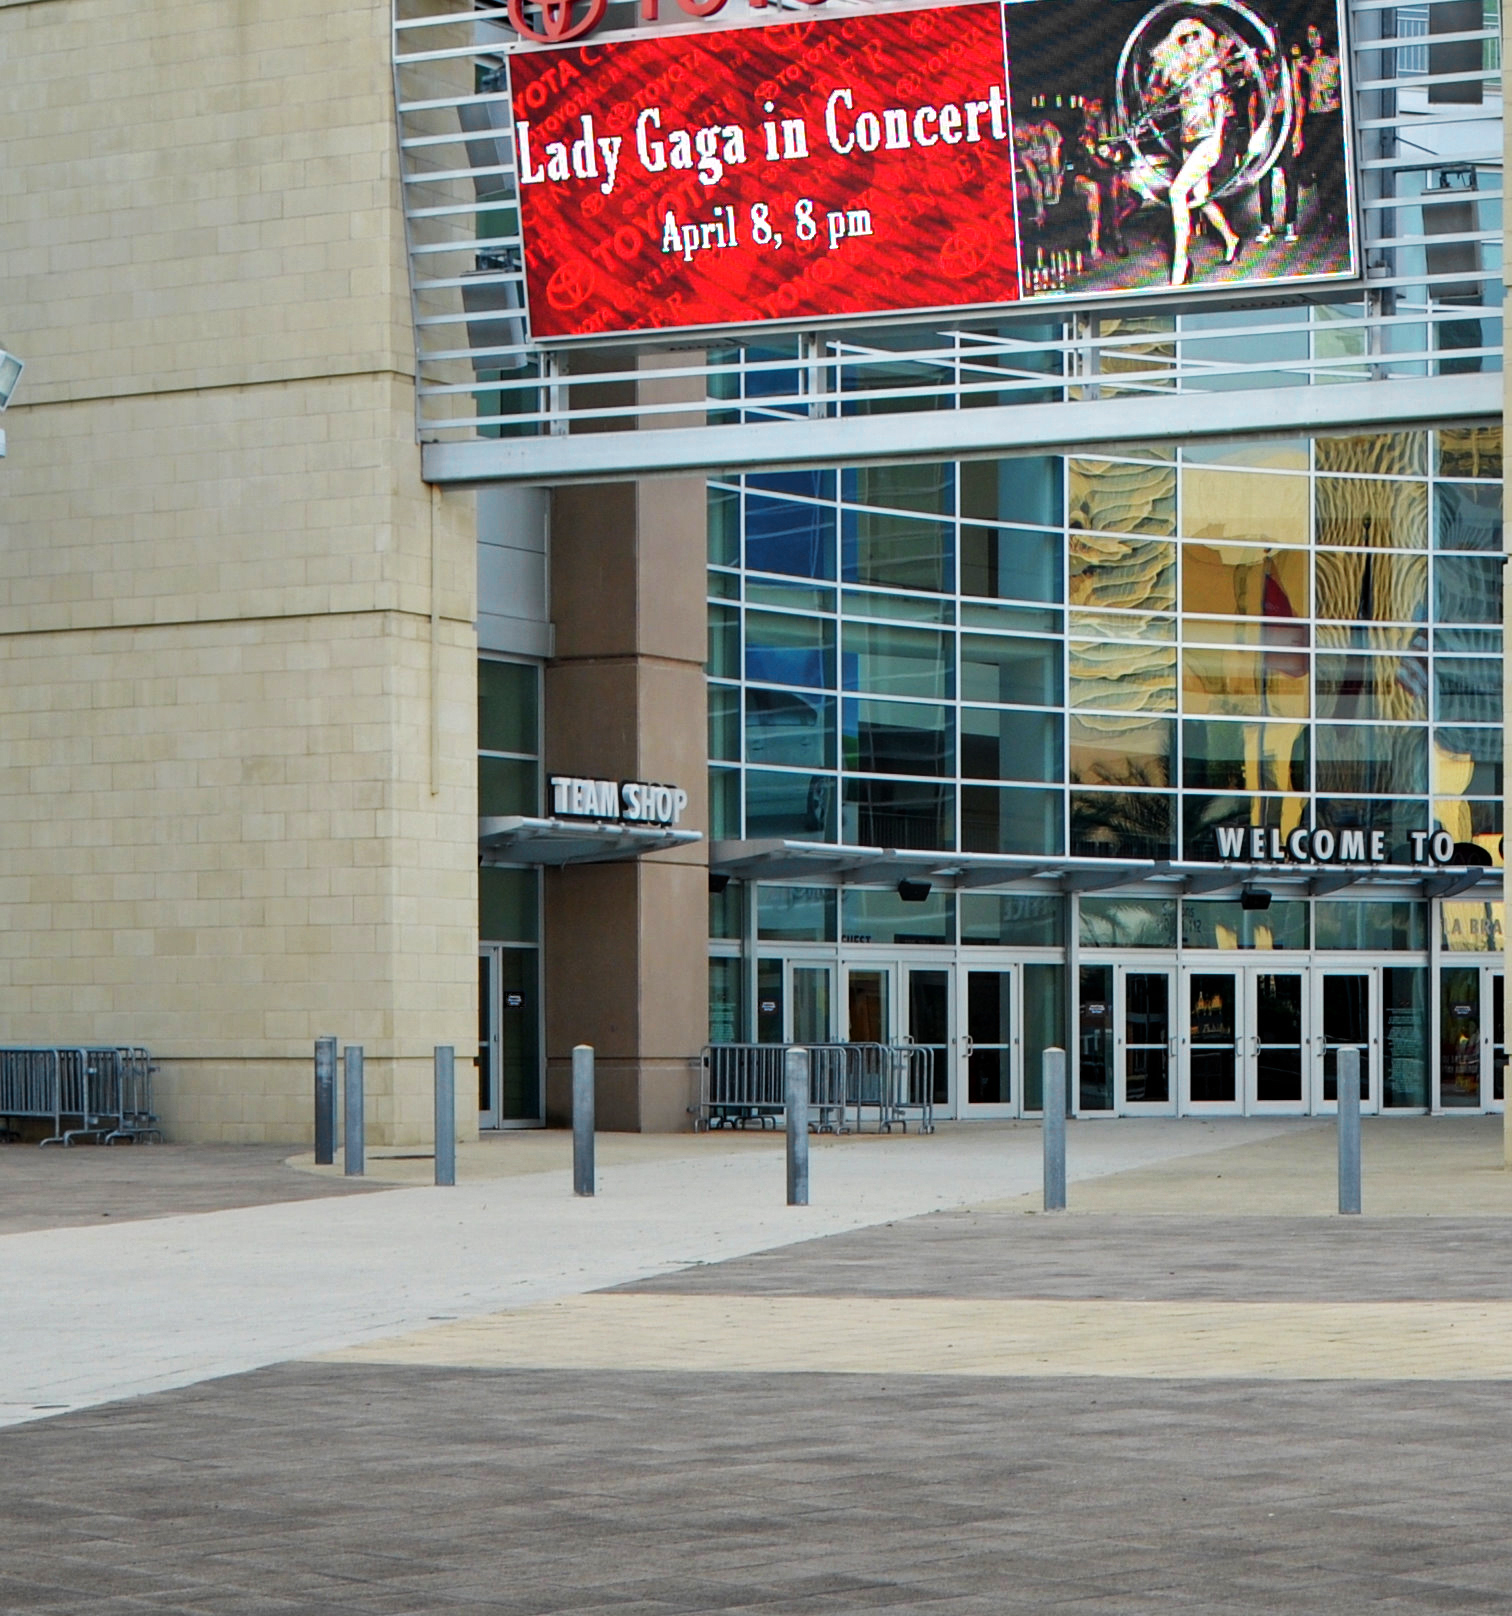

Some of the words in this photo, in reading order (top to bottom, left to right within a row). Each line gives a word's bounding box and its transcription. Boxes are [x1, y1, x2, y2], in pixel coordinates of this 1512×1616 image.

[516, 114, 622, 195] Lady
[636, 108, 747, 186] Gaga
[764, 100, 809, 161] in
[825, 86, 1007, 154] Concert
[662, 205, 738, 262] April
[750, 202, 783, 250] 8,
[794, 198, 817, 241] 8
[826, 209, 874, 250] pm
[550, 776, 620, 818] TEAM
[622, 783, 688, 824] SHOP
[1215, 826, 1385, 862] WELCOME
[1410, 830, 1455, 863] TO
